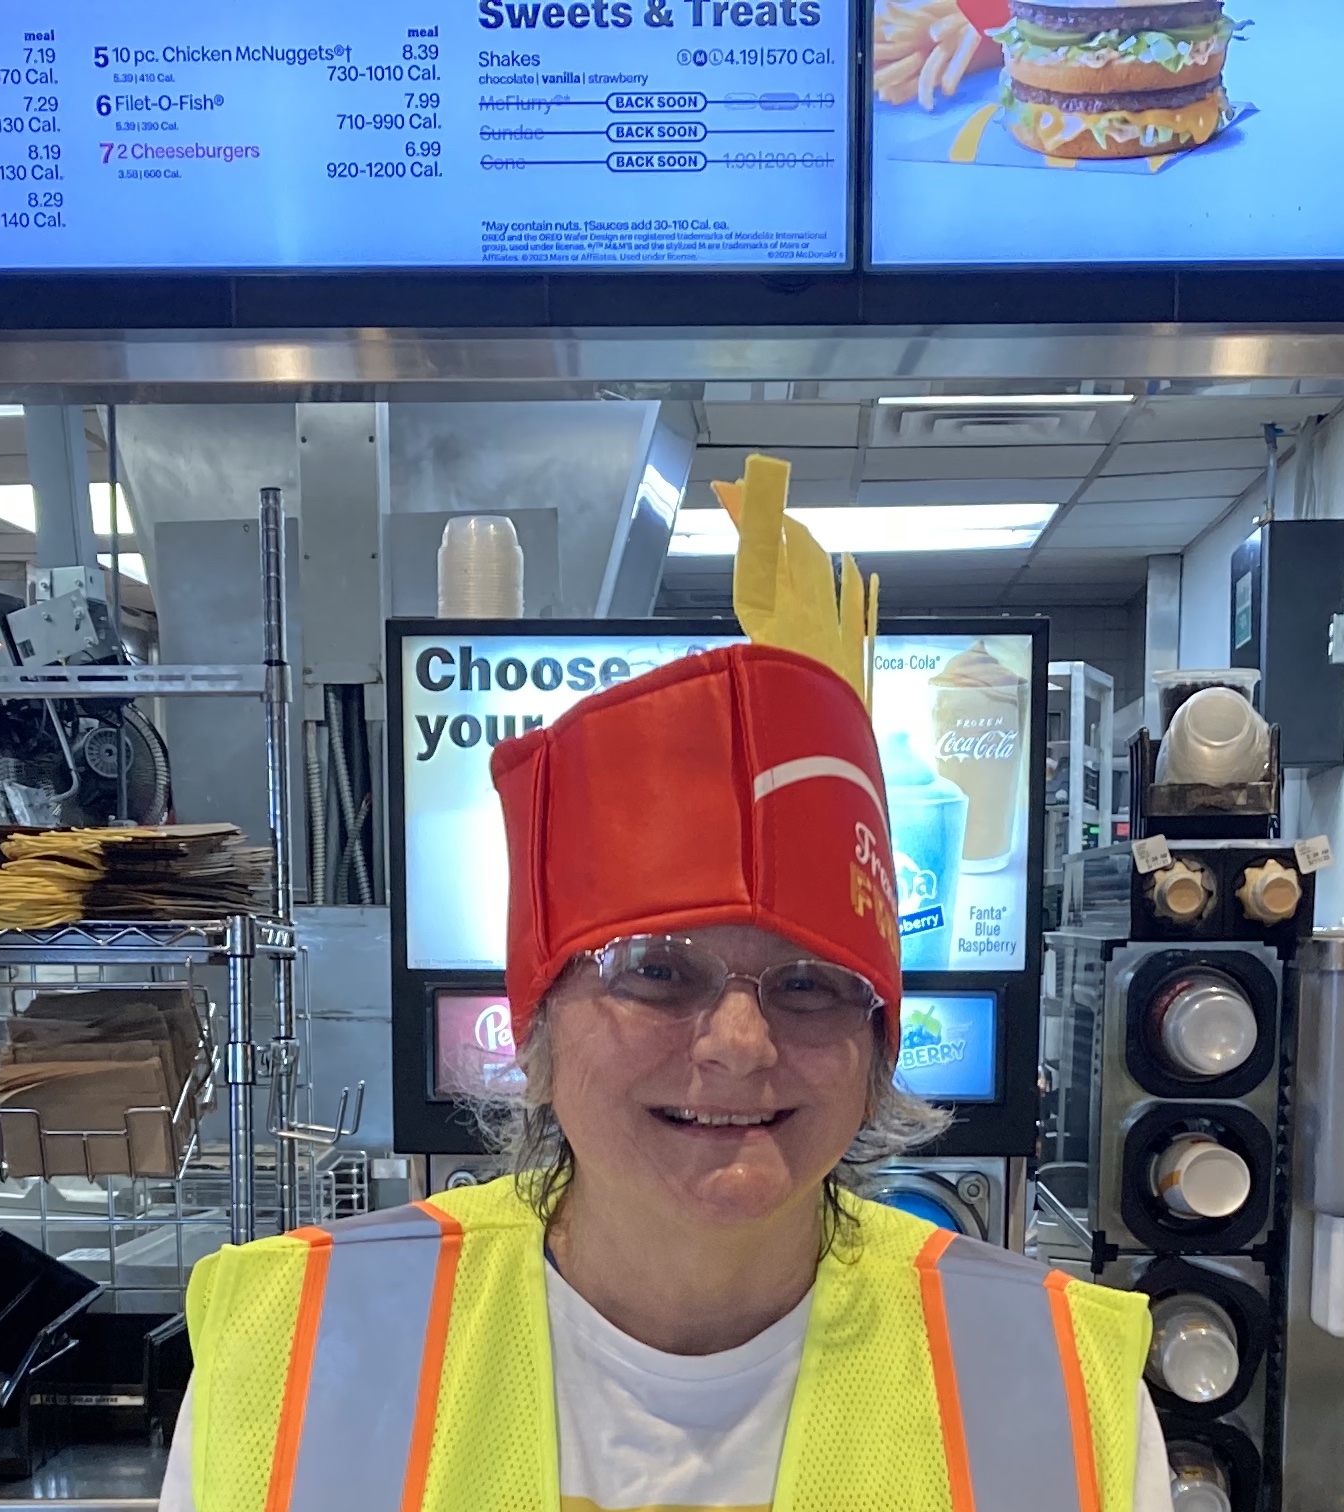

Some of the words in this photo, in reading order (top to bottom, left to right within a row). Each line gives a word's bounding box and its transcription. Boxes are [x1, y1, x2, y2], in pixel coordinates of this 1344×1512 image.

[478, 0, 632, 29] Sweets
[644, 0, 674, 28] &
[684, 0, 821, 27] Treats
[24, 30, 54, 41] meal
[408, 26, 439, 38] meal
[23, 48, 56, 64] 7.19
[94, 47, 109, 68] 5
[112, 47, 130, 63] 10
[133, 50, 159, 66] pc.
[162, 46, 232, 62] Chicken
[402, 45, 439, 60] 8.39
[478, 51, 541, 67] Shakes
[802, 48, 835, 65] Cal.
[25, 69, 58, 85] Cal.
[326, 66, 404, 82] 730-1010
[407, 65, 441, 81] Cal.
[479, 74, 534, 84] chocolate
[542, 72, 581, 84] vanilla
[588, 72, 648, 86] strawberry
[24, 97, 58, 112] 7.29
[96, 95, 111, 116] 6
[404, 93, 440, 109] 7.99
[615, 97, 654, 108] BACK
[657, 96, 698, 108] SOON
[28, 117, 60, 133] Cal.
[337, 114, 405, 130] 710-990
[409, 114, 442, 129] Cal.
[615, 126, 654, 138] BACK
[657, 126, 698, 138] SOON
[28, 145, 61, 161] 8.19
[99, 143, 114, 163] 7
[117, 144, 128, 160] 2
[131, 143, 260, 162] Cheeseburgers
[405, 142, 441, 157] 6.99
[615, 156, 654, 168] BACK
[657, 155, 698, 168] SOON
[32, 165, 64, 181] Cal.
[327, 162, 406, 178] 920-1200
[410, 162, 443, 178] Cal.
[28, 193, 64, 208] 8.29
[34, 212, 66, 228] Cal.
[511, 221, 552, 231] contain
[631, 221, 652, 231] add
[415, 646, 630, 692] Choose
[956, 717, 1004, 728] FROZEN
[415, 706, 543, 760] your
[975, 922, 1001, 936] Blue
[958, 938, 1016, 956] Raspberry
